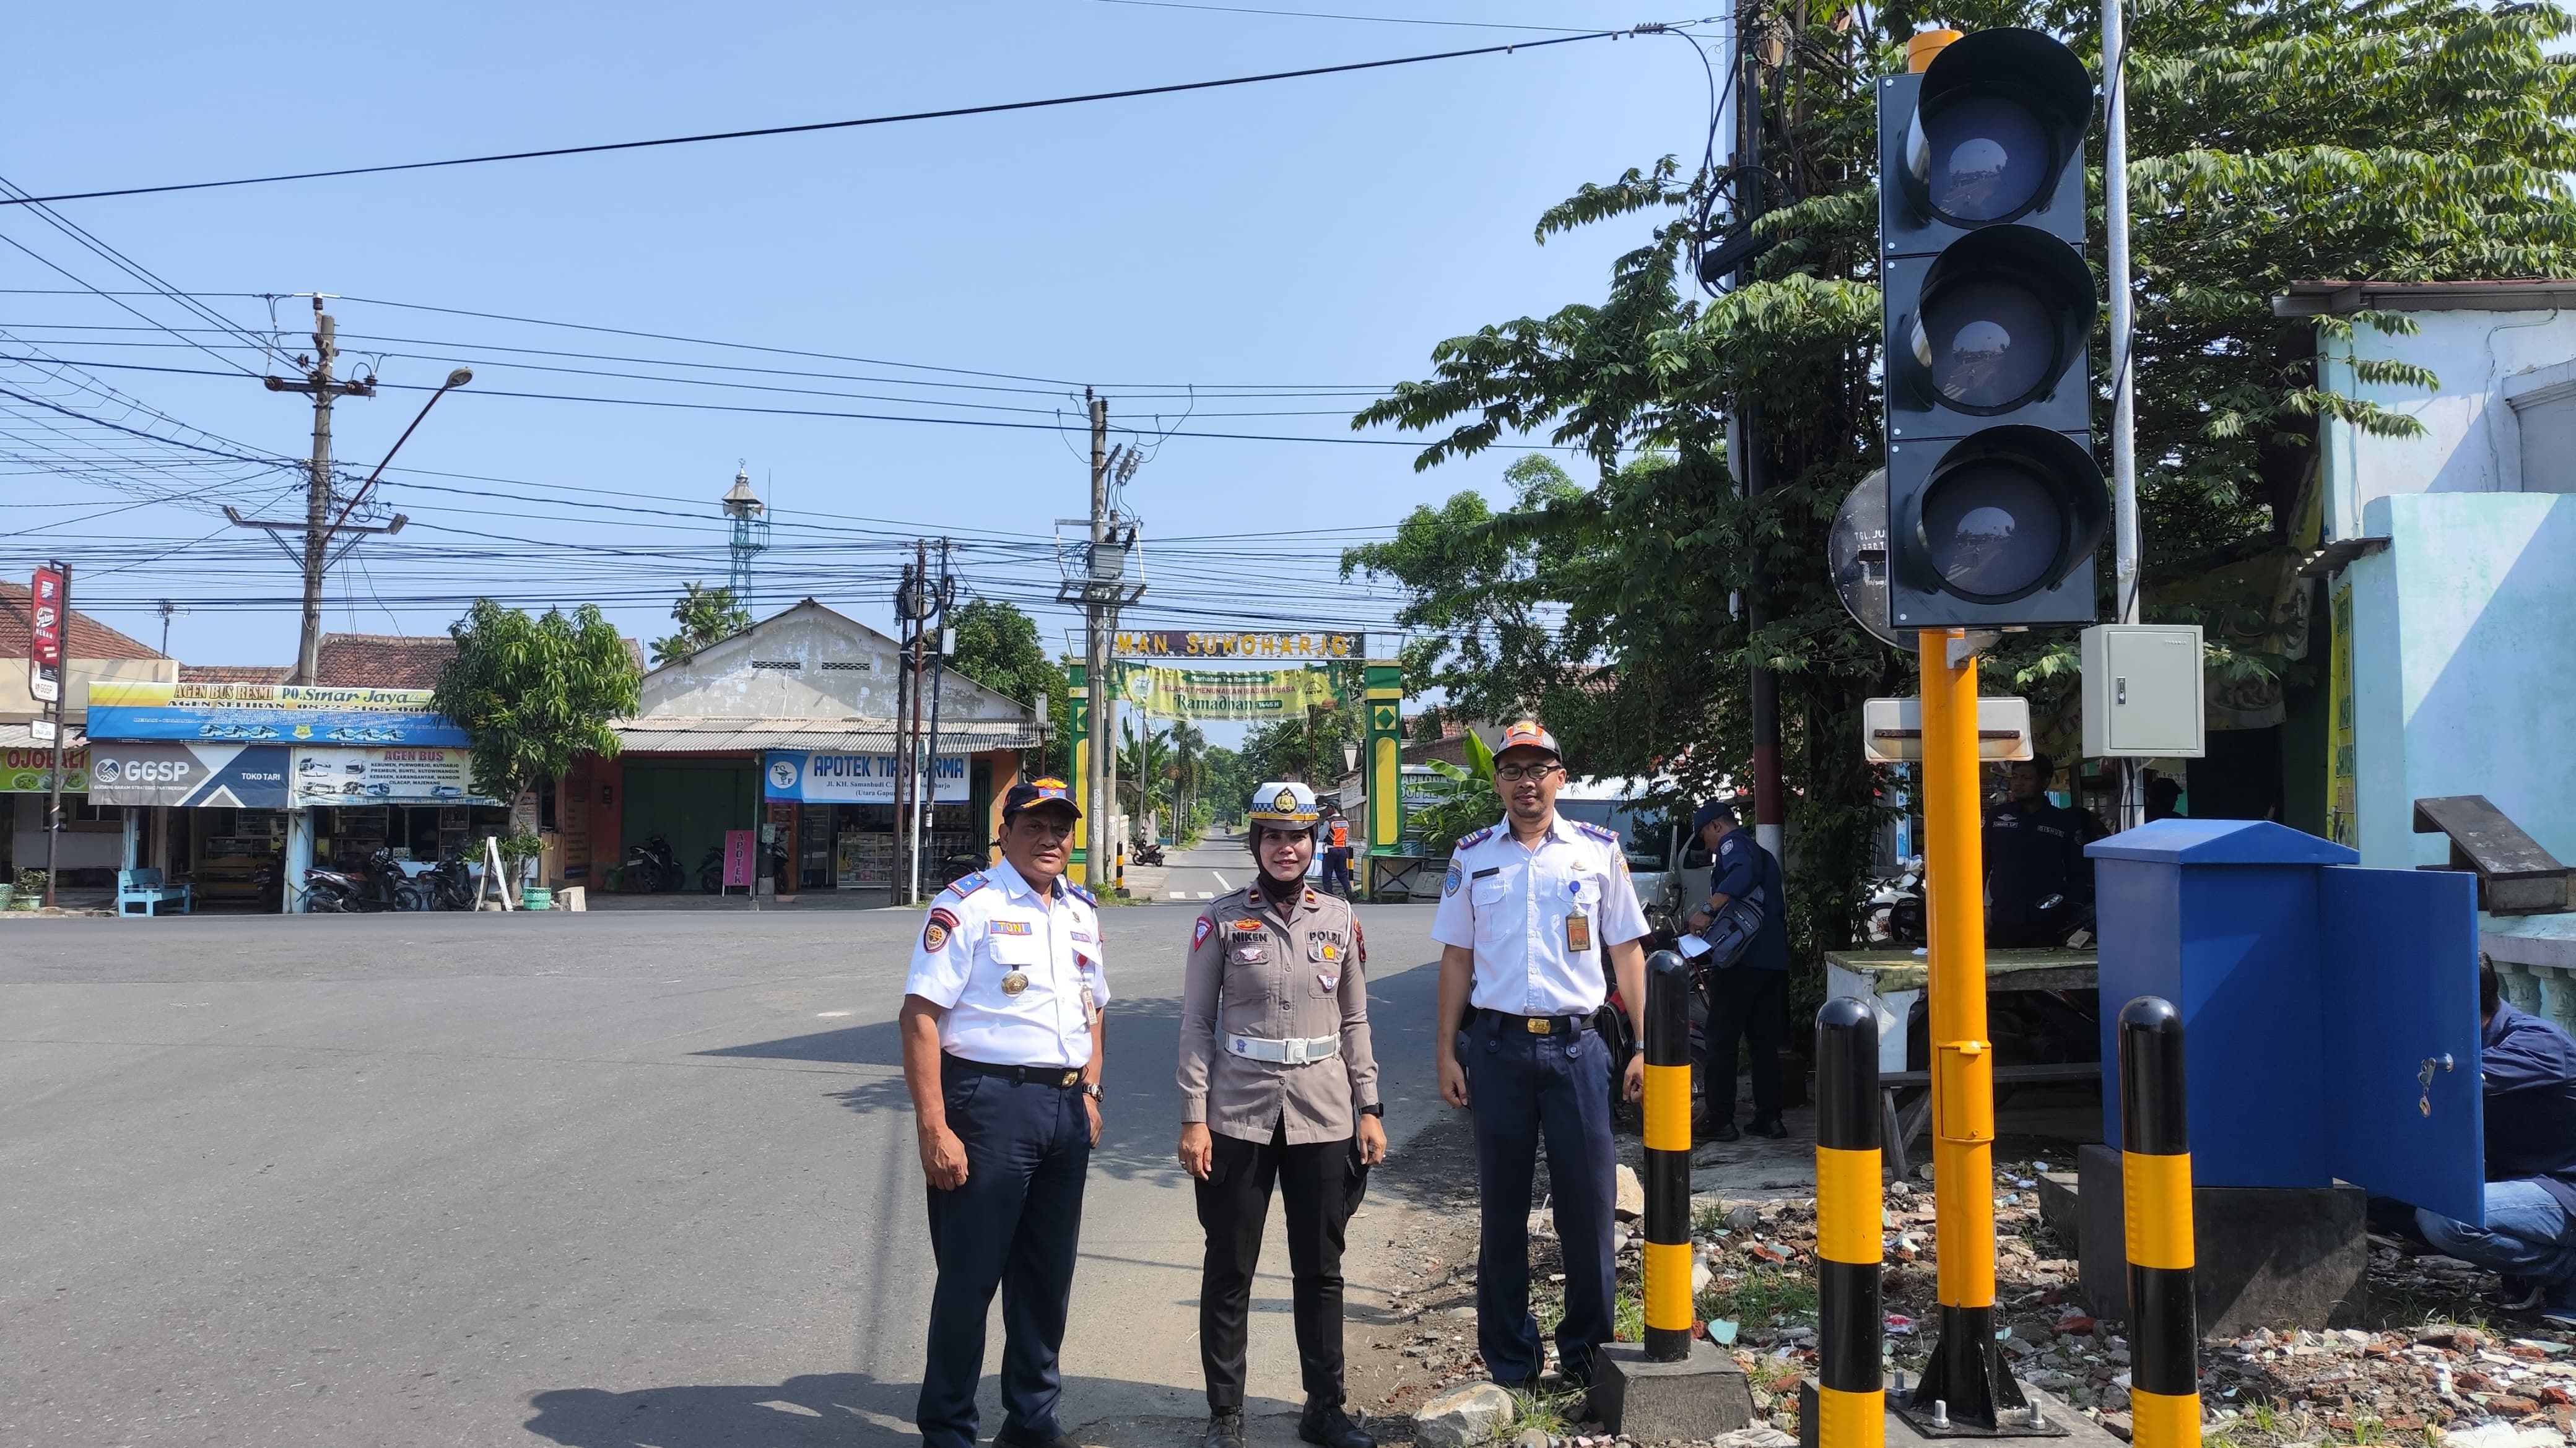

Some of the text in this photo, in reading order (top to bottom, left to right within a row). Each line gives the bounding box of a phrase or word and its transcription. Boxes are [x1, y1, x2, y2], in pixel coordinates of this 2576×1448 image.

[1117, 634, 1347, 656] MAN SUKOHARJO
[174, 685, 207, 699] AGEN
[209, 685, 234, 700] BUS
[236, 686, 274, 701] RESMI
[363, 690, 407, 705] Jaya
[1160, 685, 1194, 693] SELAMAT
[1243, 686, 1270, 695] IBADAH
[1271, 685, 1296, 694] PUASA
[1174, 694, 1254, 711] Ramadhan
[384, 751, 443, 761] AGEN BUS
[125, 761, 189, 782] GGSP
[814, 756, 872, 777] APOTEK
[734, 833, 744, 883] APOTEK
[999, 922, 1025, 932] TONI
[1232, 932, 1268, 943] NIKEN
[1309, 930, 1341, 945] POLRI
